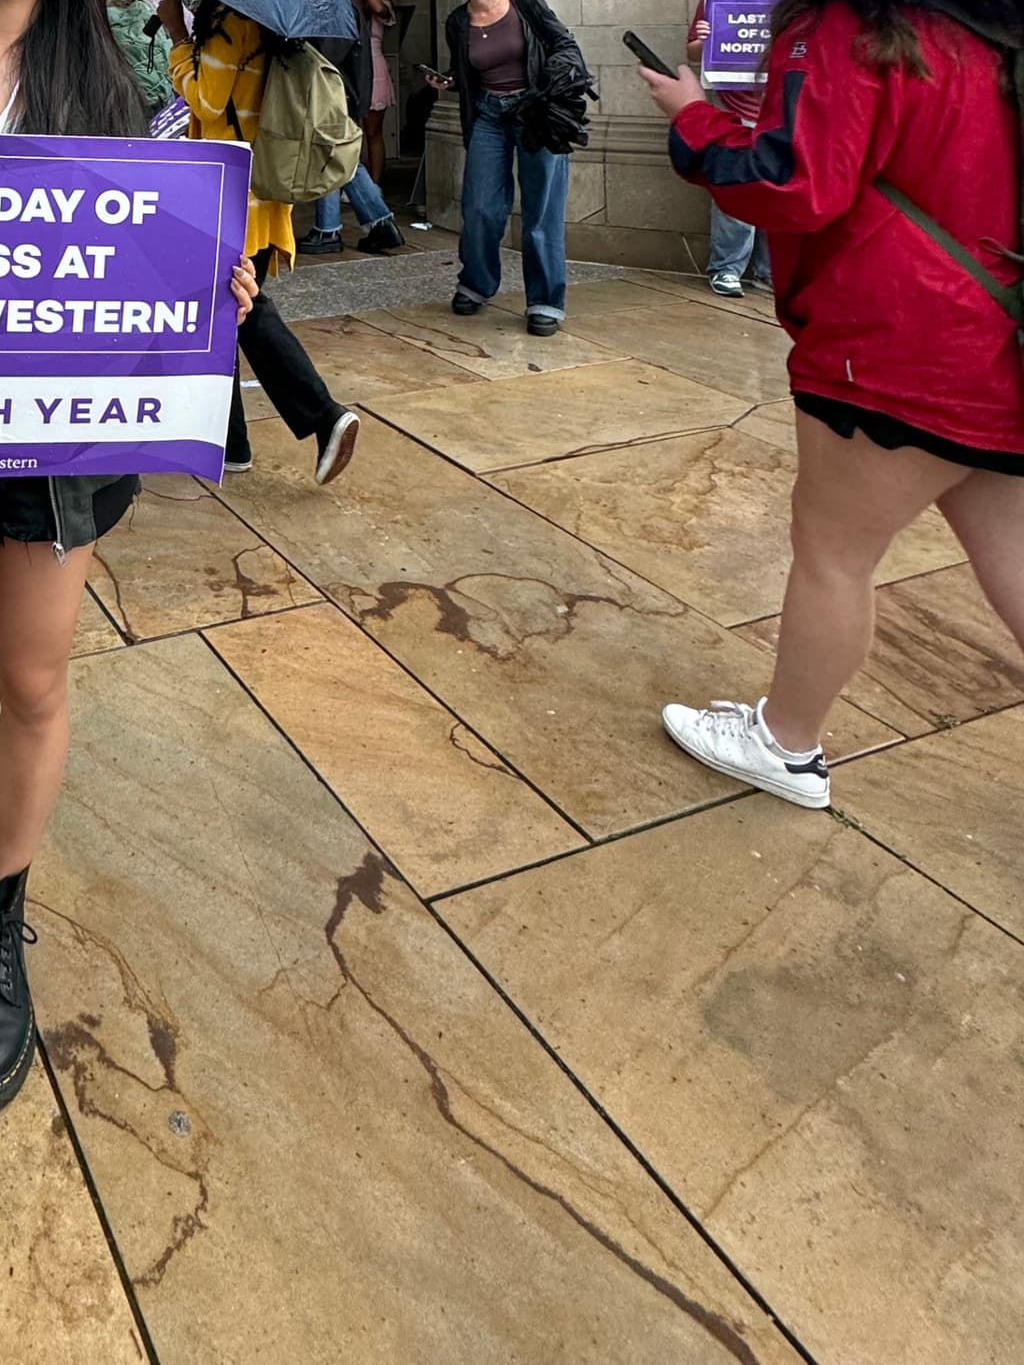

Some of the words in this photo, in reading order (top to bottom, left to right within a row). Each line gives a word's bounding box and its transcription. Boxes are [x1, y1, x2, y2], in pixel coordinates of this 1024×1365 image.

[728, 14, 766, 24] LAST
[737, 28, 758, 39] OF
[95, 189, 159, 225] OF
[53, 245, 116, 279] AT
[34, 397, 162, 425] YEAR
